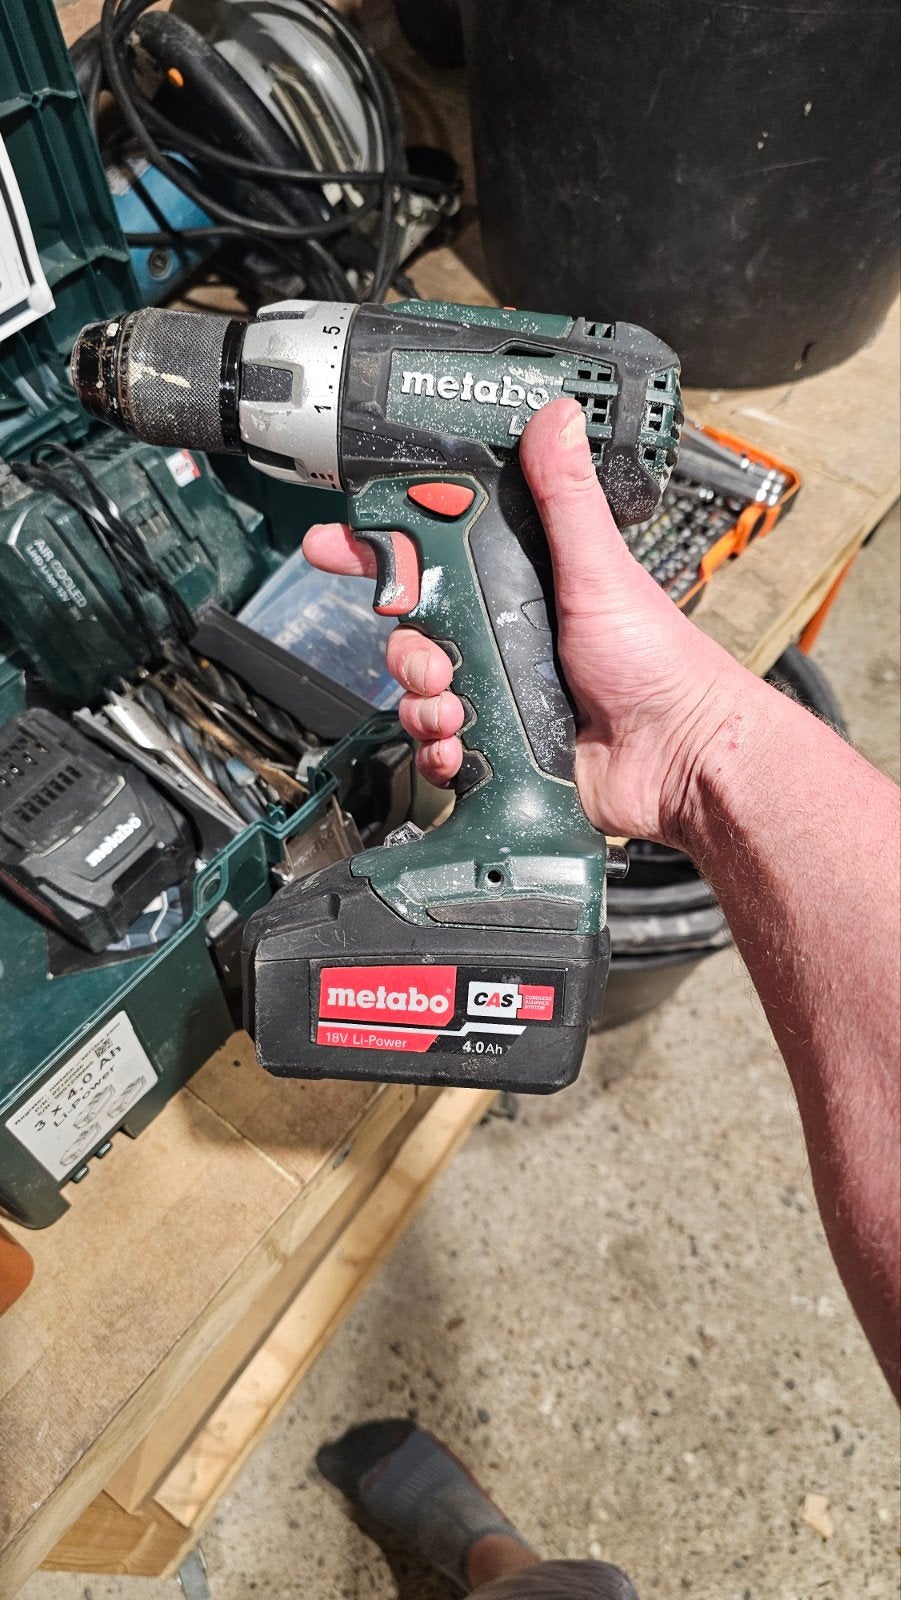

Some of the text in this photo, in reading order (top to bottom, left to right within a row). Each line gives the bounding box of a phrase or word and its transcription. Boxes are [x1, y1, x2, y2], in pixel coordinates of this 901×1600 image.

[323, 326, 340, 335] 5
[400, 371, 549, 411] metabo
[314, 405, 331, 414] 1
[33, 539, 87, 608] AIR COOLED
[85, 817, 142, 867] metabo
[327, 986, 449, 1014] metabo
[474, 992, 514, 1008] CAS
[524, 999, 549, 1007] ALLIANCE
[326, 1033, 408, 1049] 18V Li-Power
[35, 1120, 46, 1132] 3
[52, 1105, 63, 1116] x
[100, 1046, 121, 1070] Ah
[53, 1065, 115, 1127] Li-Power
